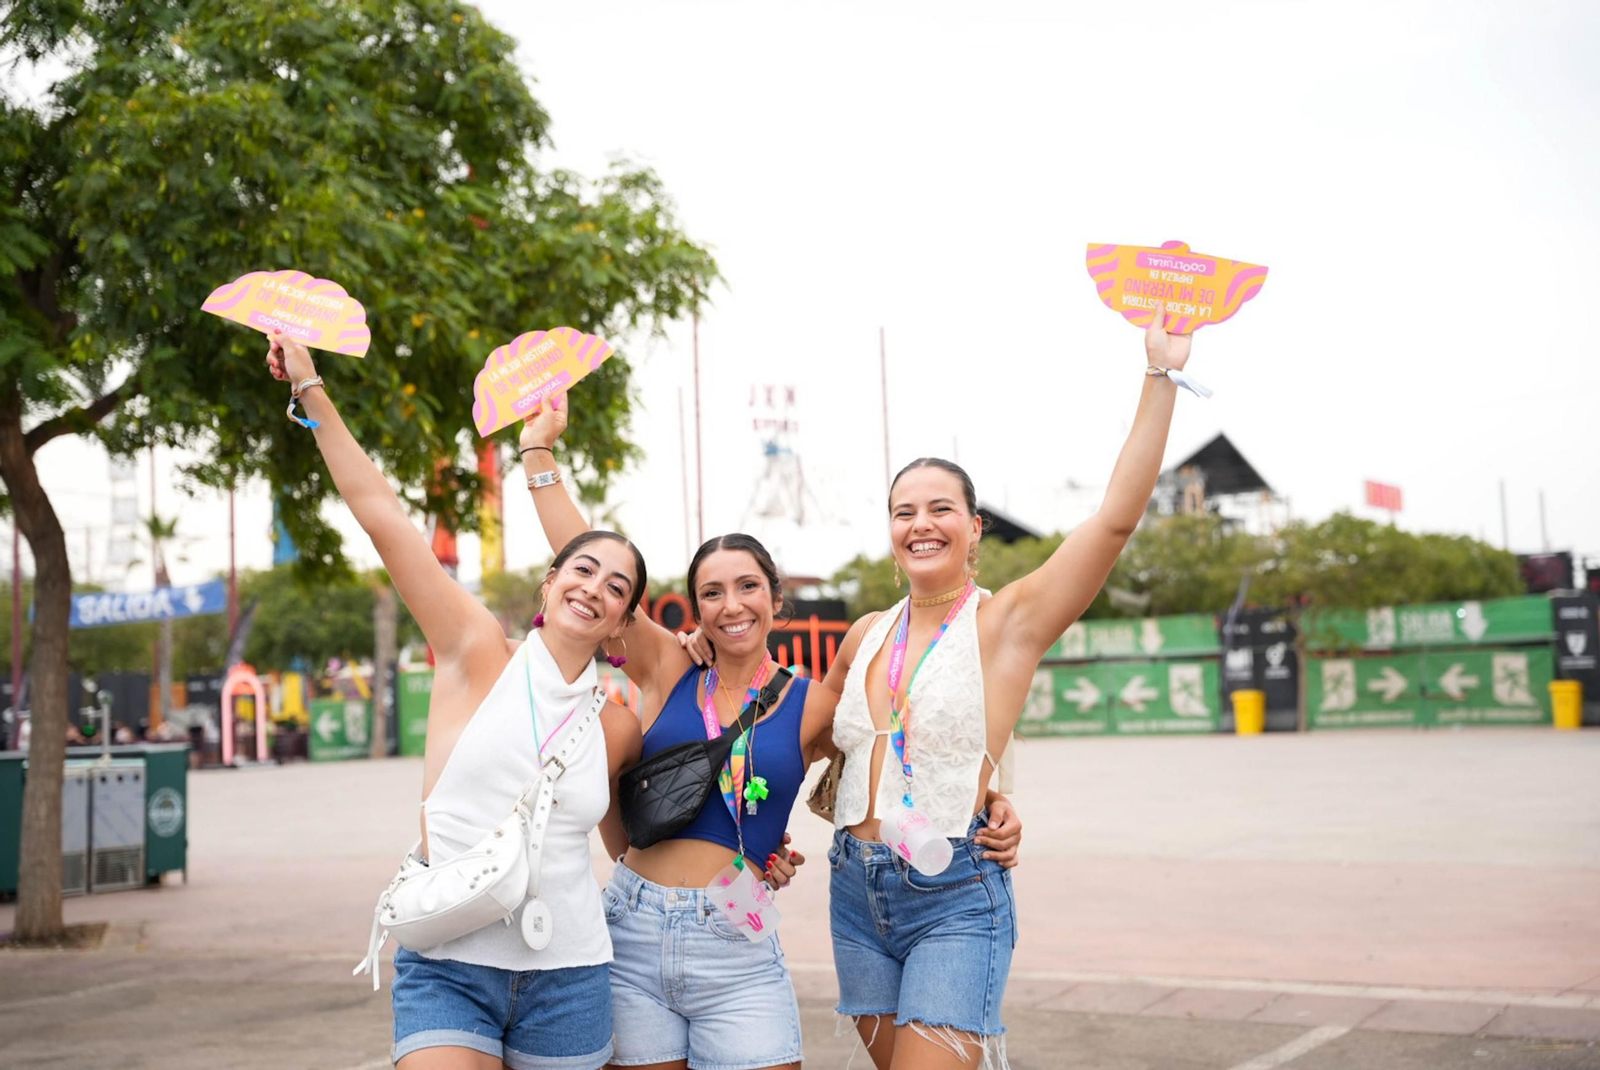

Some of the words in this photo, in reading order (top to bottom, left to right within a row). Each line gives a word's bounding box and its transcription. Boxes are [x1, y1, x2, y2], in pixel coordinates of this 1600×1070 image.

[1146, 257, 1207, 273] COOLTURAL
[1149, 270, 1159, 279] EN
[1123, 277, 1174, 299] VERANO
[1161, 271, 1195, 284] EMPIEZA
[263, 278, 275, 289] LA
[276, 283, 307, 301] MEJOR
[307, 293, 345, 311] HISTORIA
[1121, 294, 1165, 312] ISTORIA
[1179, 285, 1195, 300] MI
[1198, 288, 1216, 305] DE
[256, 288, 272, 301] DE
[277, 295, 291, 309] MI
[293, 301, 341, 323] VERANO
[1165, 300, 1198, 316] MEJOR
[1199, 305, 1212, 318] LA
[257, 315, 311, 338] COOLTURAL
[487, 371, 499, 383] LA
[498, 358, 523, 377] MEJOR
[520, 338, 557, 366] HISTORIA
[494, 381, 509, 395] DE
[508, 372, 523, 389] MI
[521, 347, 565, 380] VERANO
[517, 378, 562, 409] COOLTURAL
[77, 588, 174, 625] SALIDA
[704, 705, 718, 738] OOLTURAL
